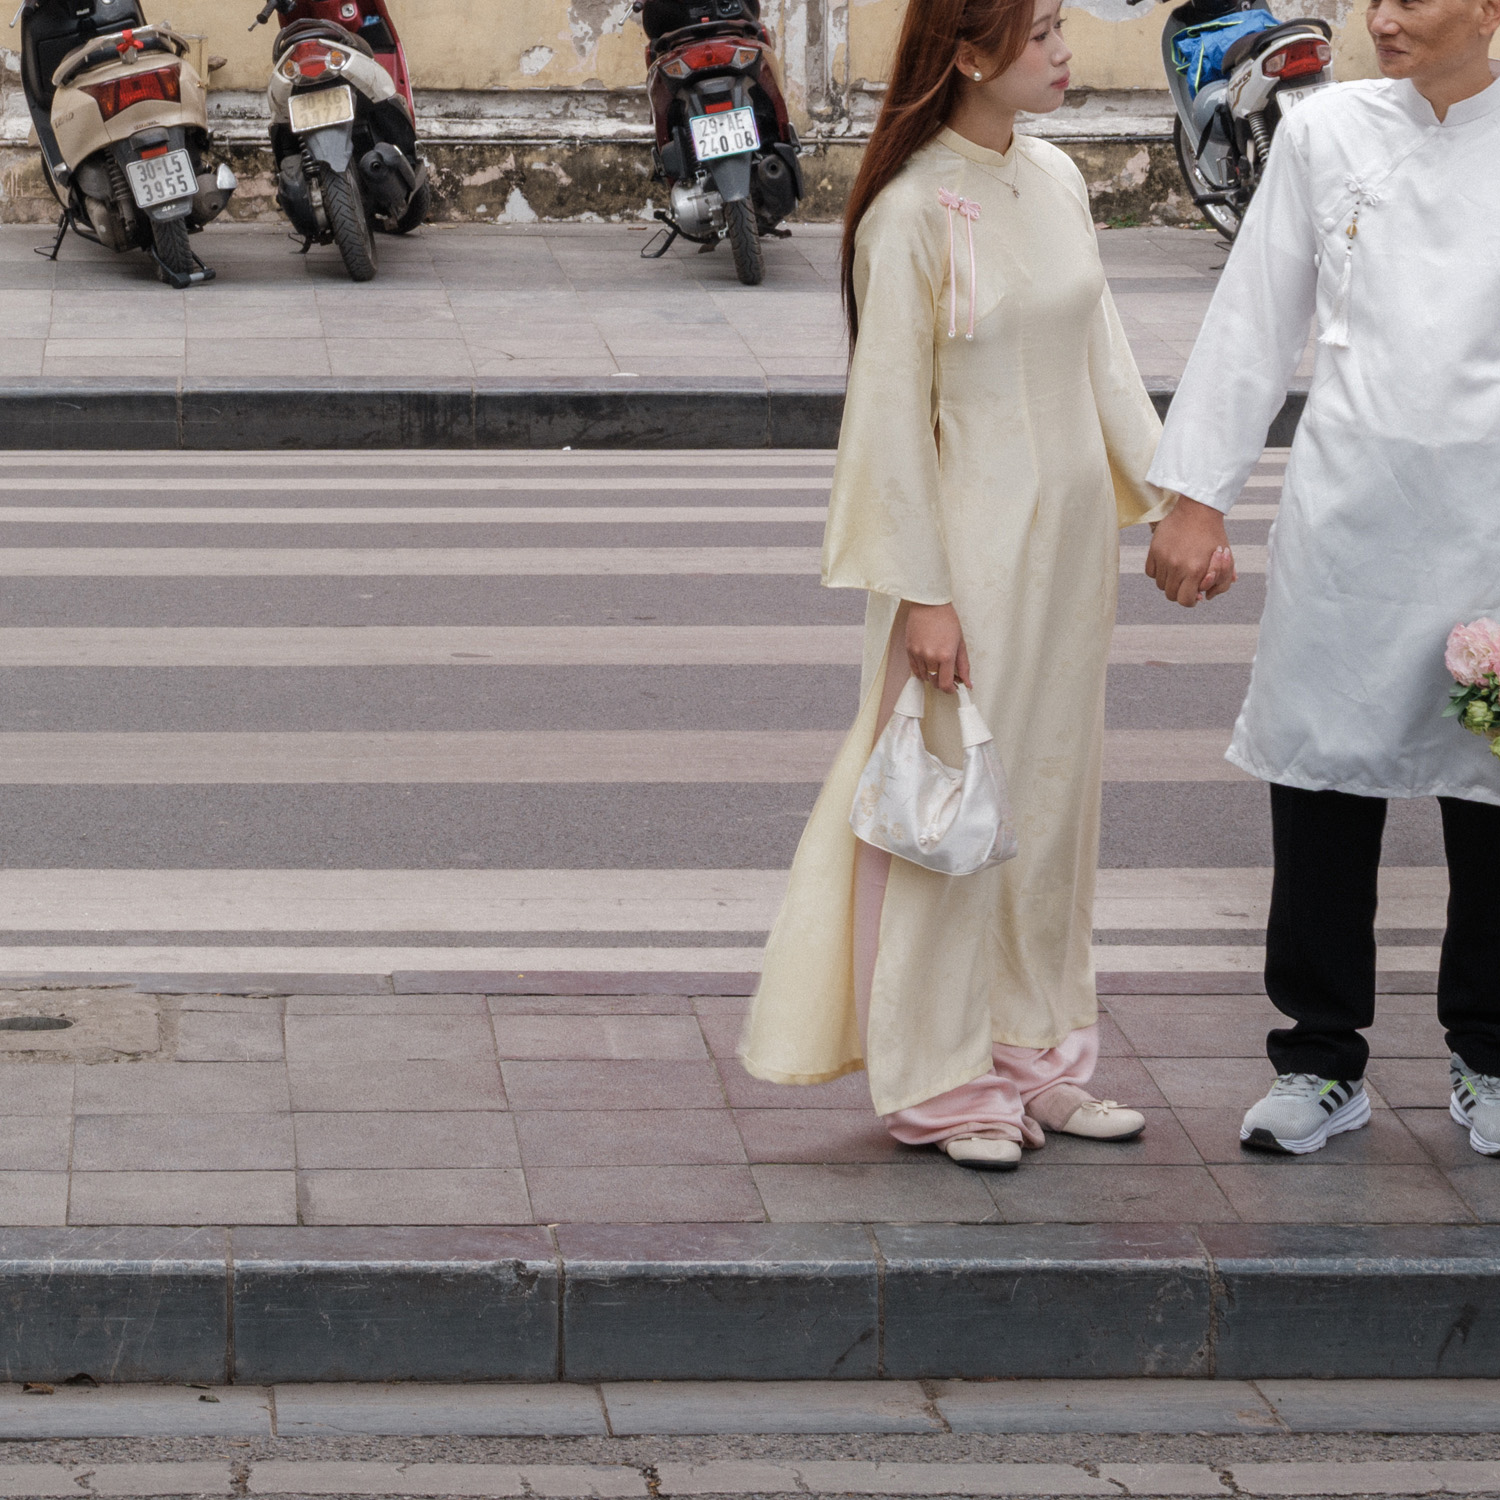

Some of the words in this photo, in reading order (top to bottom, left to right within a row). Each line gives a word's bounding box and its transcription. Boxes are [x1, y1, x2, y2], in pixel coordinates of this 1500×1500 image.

[699, 131, 754, 157] 240.08
[136, 155, 182, 183] 30-L5
[143, 174, 188, 202] 3955
